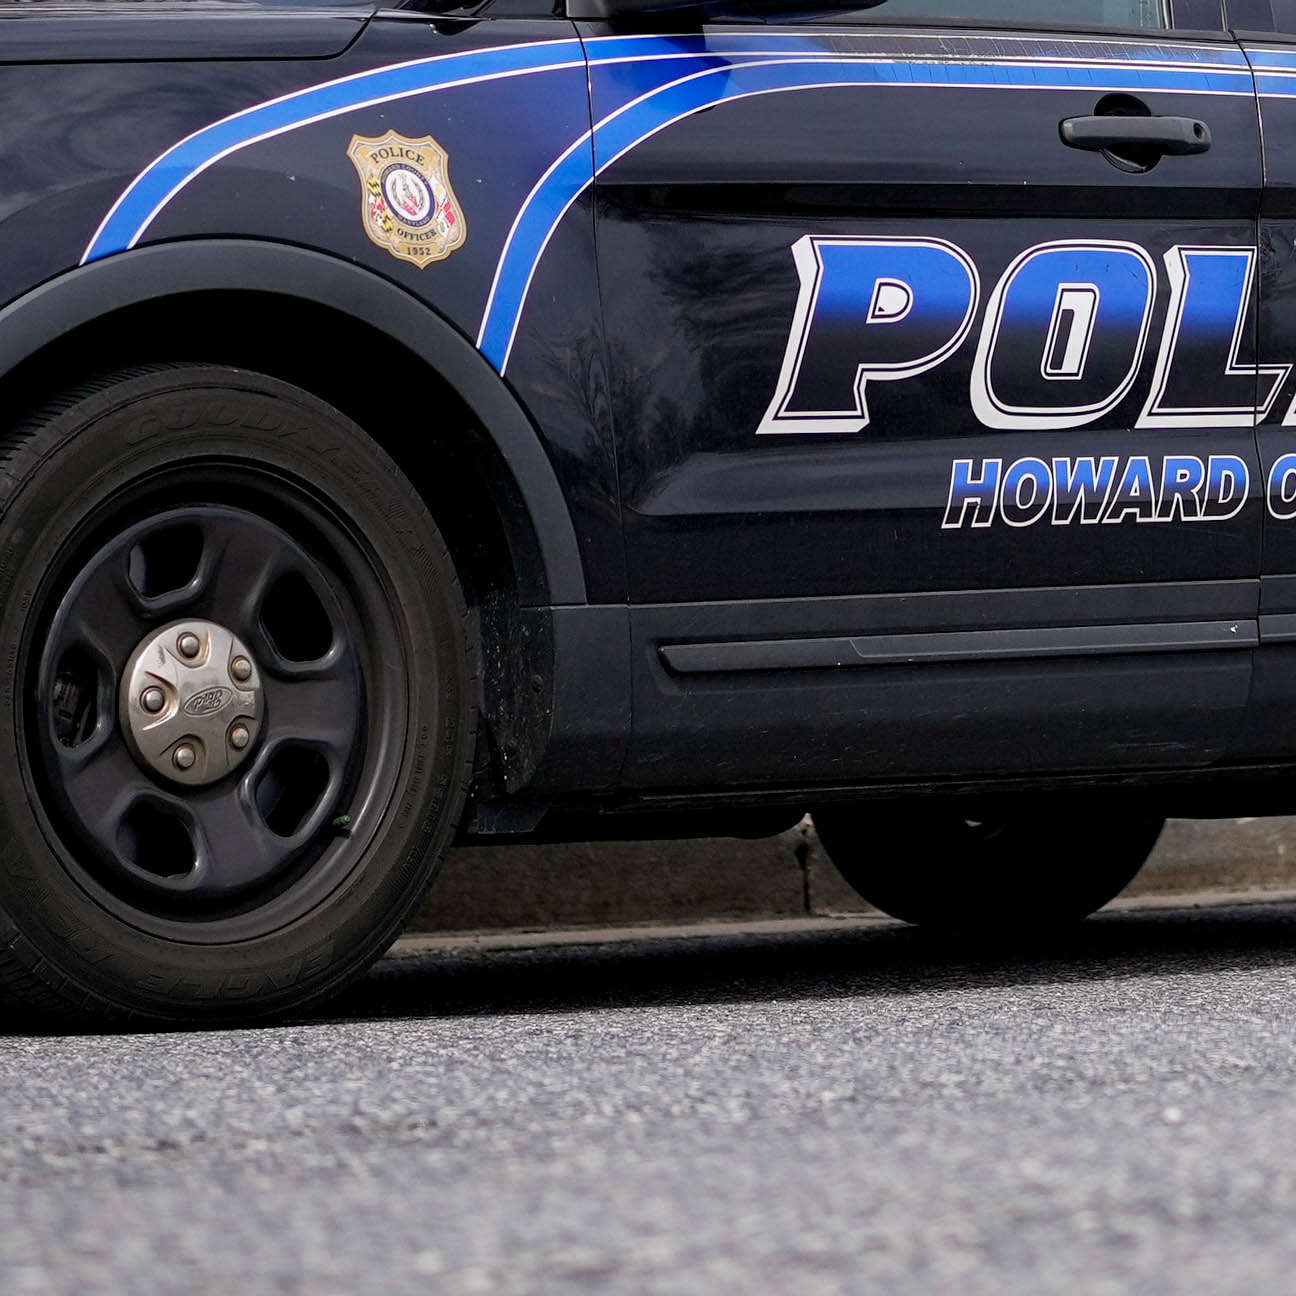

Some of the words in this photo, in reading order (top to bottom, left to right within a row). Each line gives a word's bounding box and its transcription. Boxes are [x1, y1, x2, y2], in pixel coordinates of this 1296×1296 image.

[370, 146, 425, 166] POLICE
[396, 227, 437, 242] OFFICER
[407, 246, 432, 256] 1952
[940, 454, 1250, 529] HOWARD
